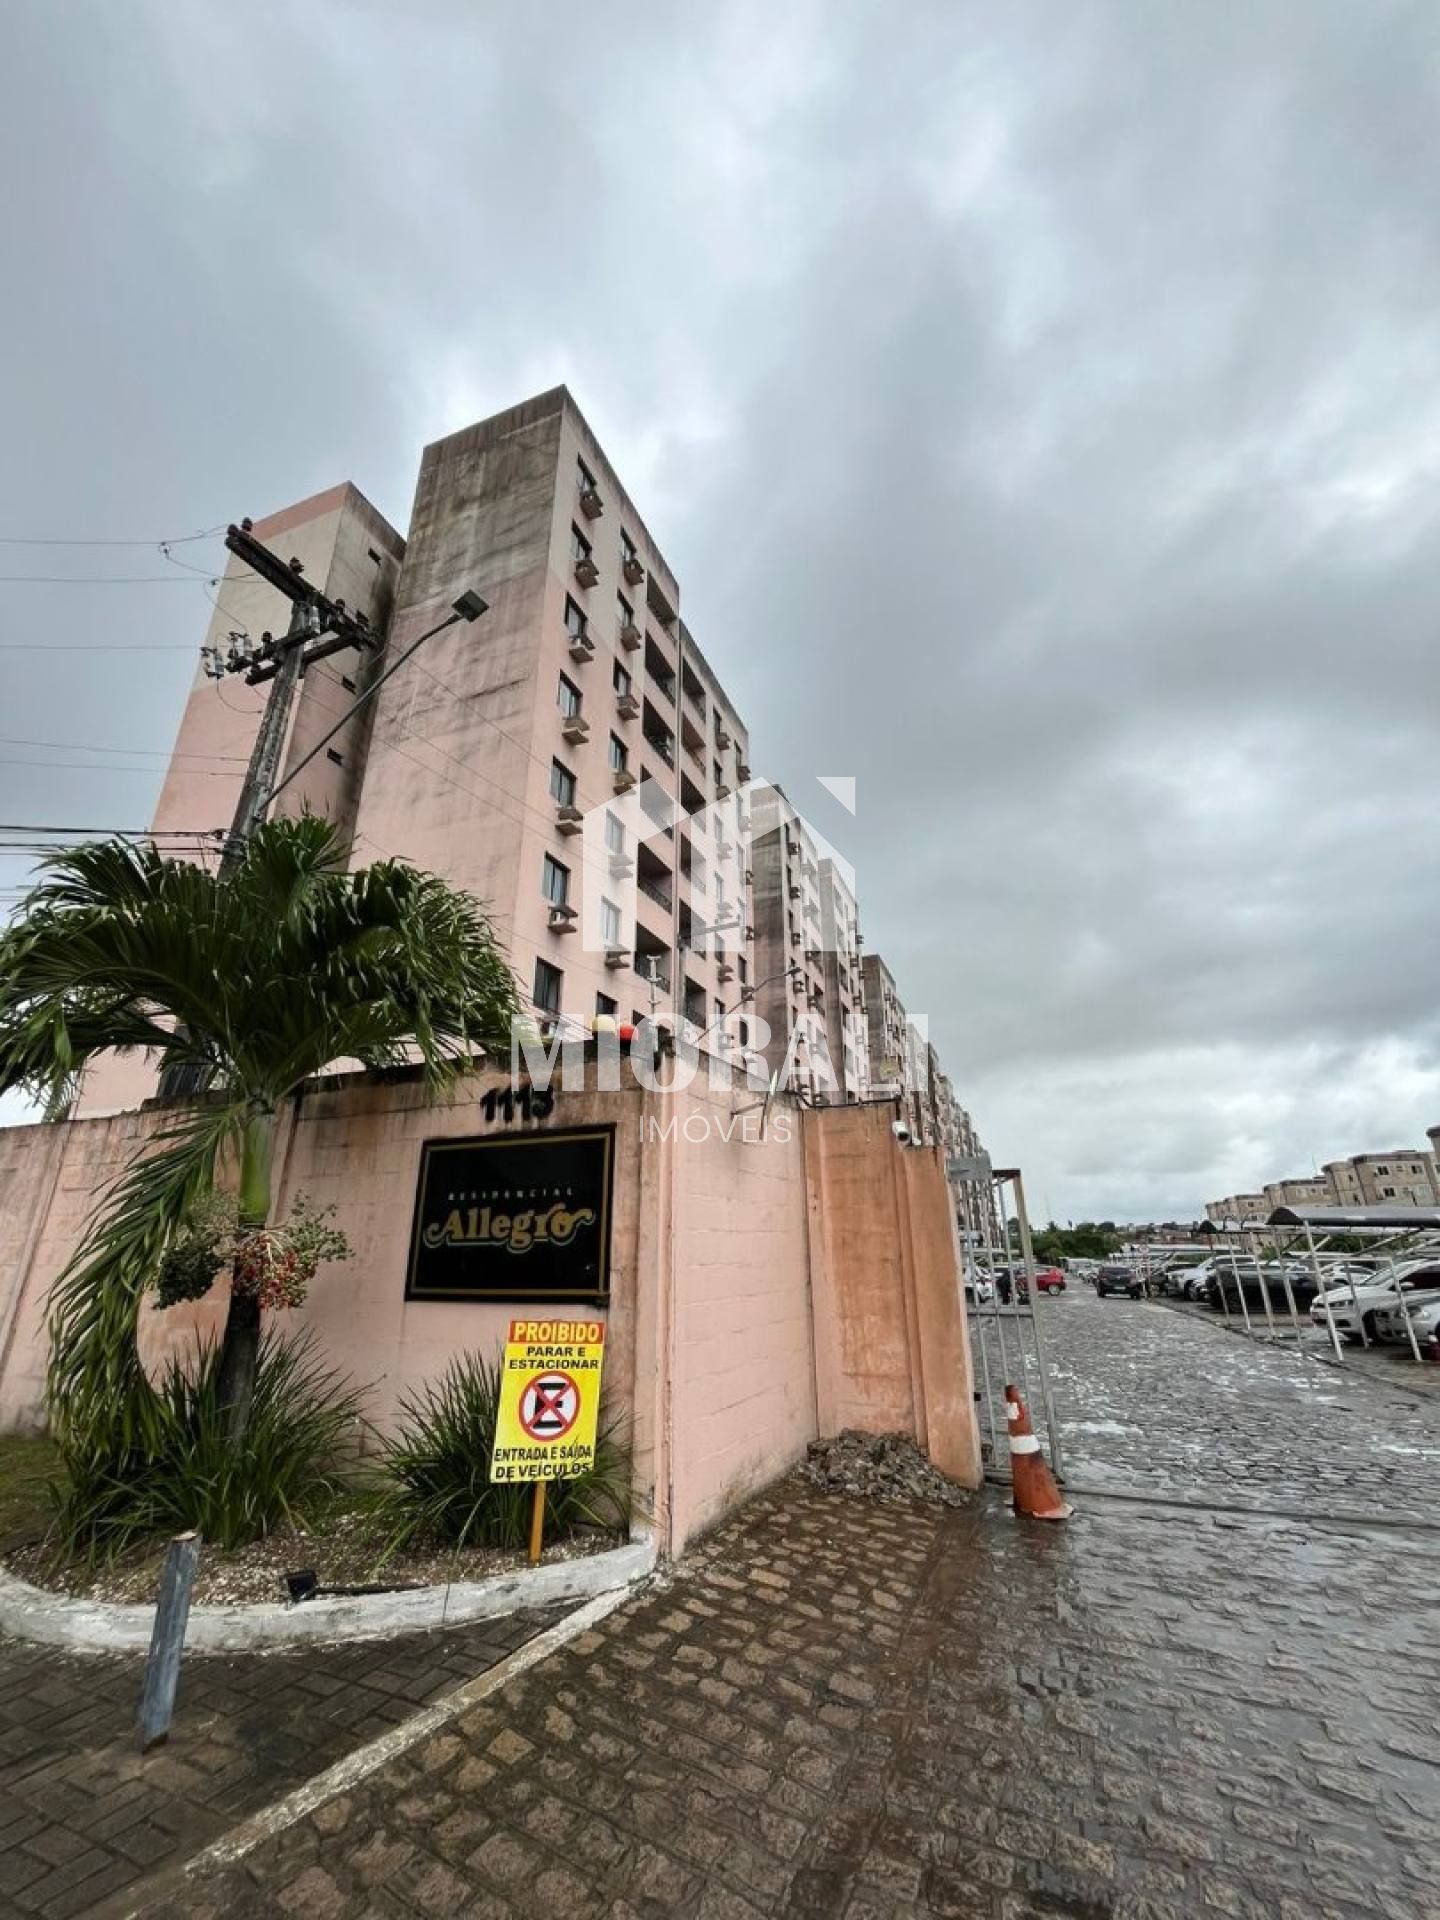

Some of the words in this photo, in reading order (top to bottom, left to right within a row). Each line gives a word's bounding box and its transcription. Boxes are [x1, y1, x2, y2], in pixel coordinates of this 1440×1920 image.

[448, 1187, 572, 1200] RESIDENCIAL
[424, 1202, 595, 1252] Allegro
[513, 1322, 600, 1342] PROIBIDO
[527, 1346, 573, 1357] PARAR
[577, 1346, 586, 1357] E
[509, 1359, 599, 1370] ESTACIONAR
[494, 1446, 548, 1462] ENTRADA
[550, 1446, 558, 1460] E
[495, 1466, 515, 1479] DE
[518, 1462, 590, 1477] VEÍCULOS
